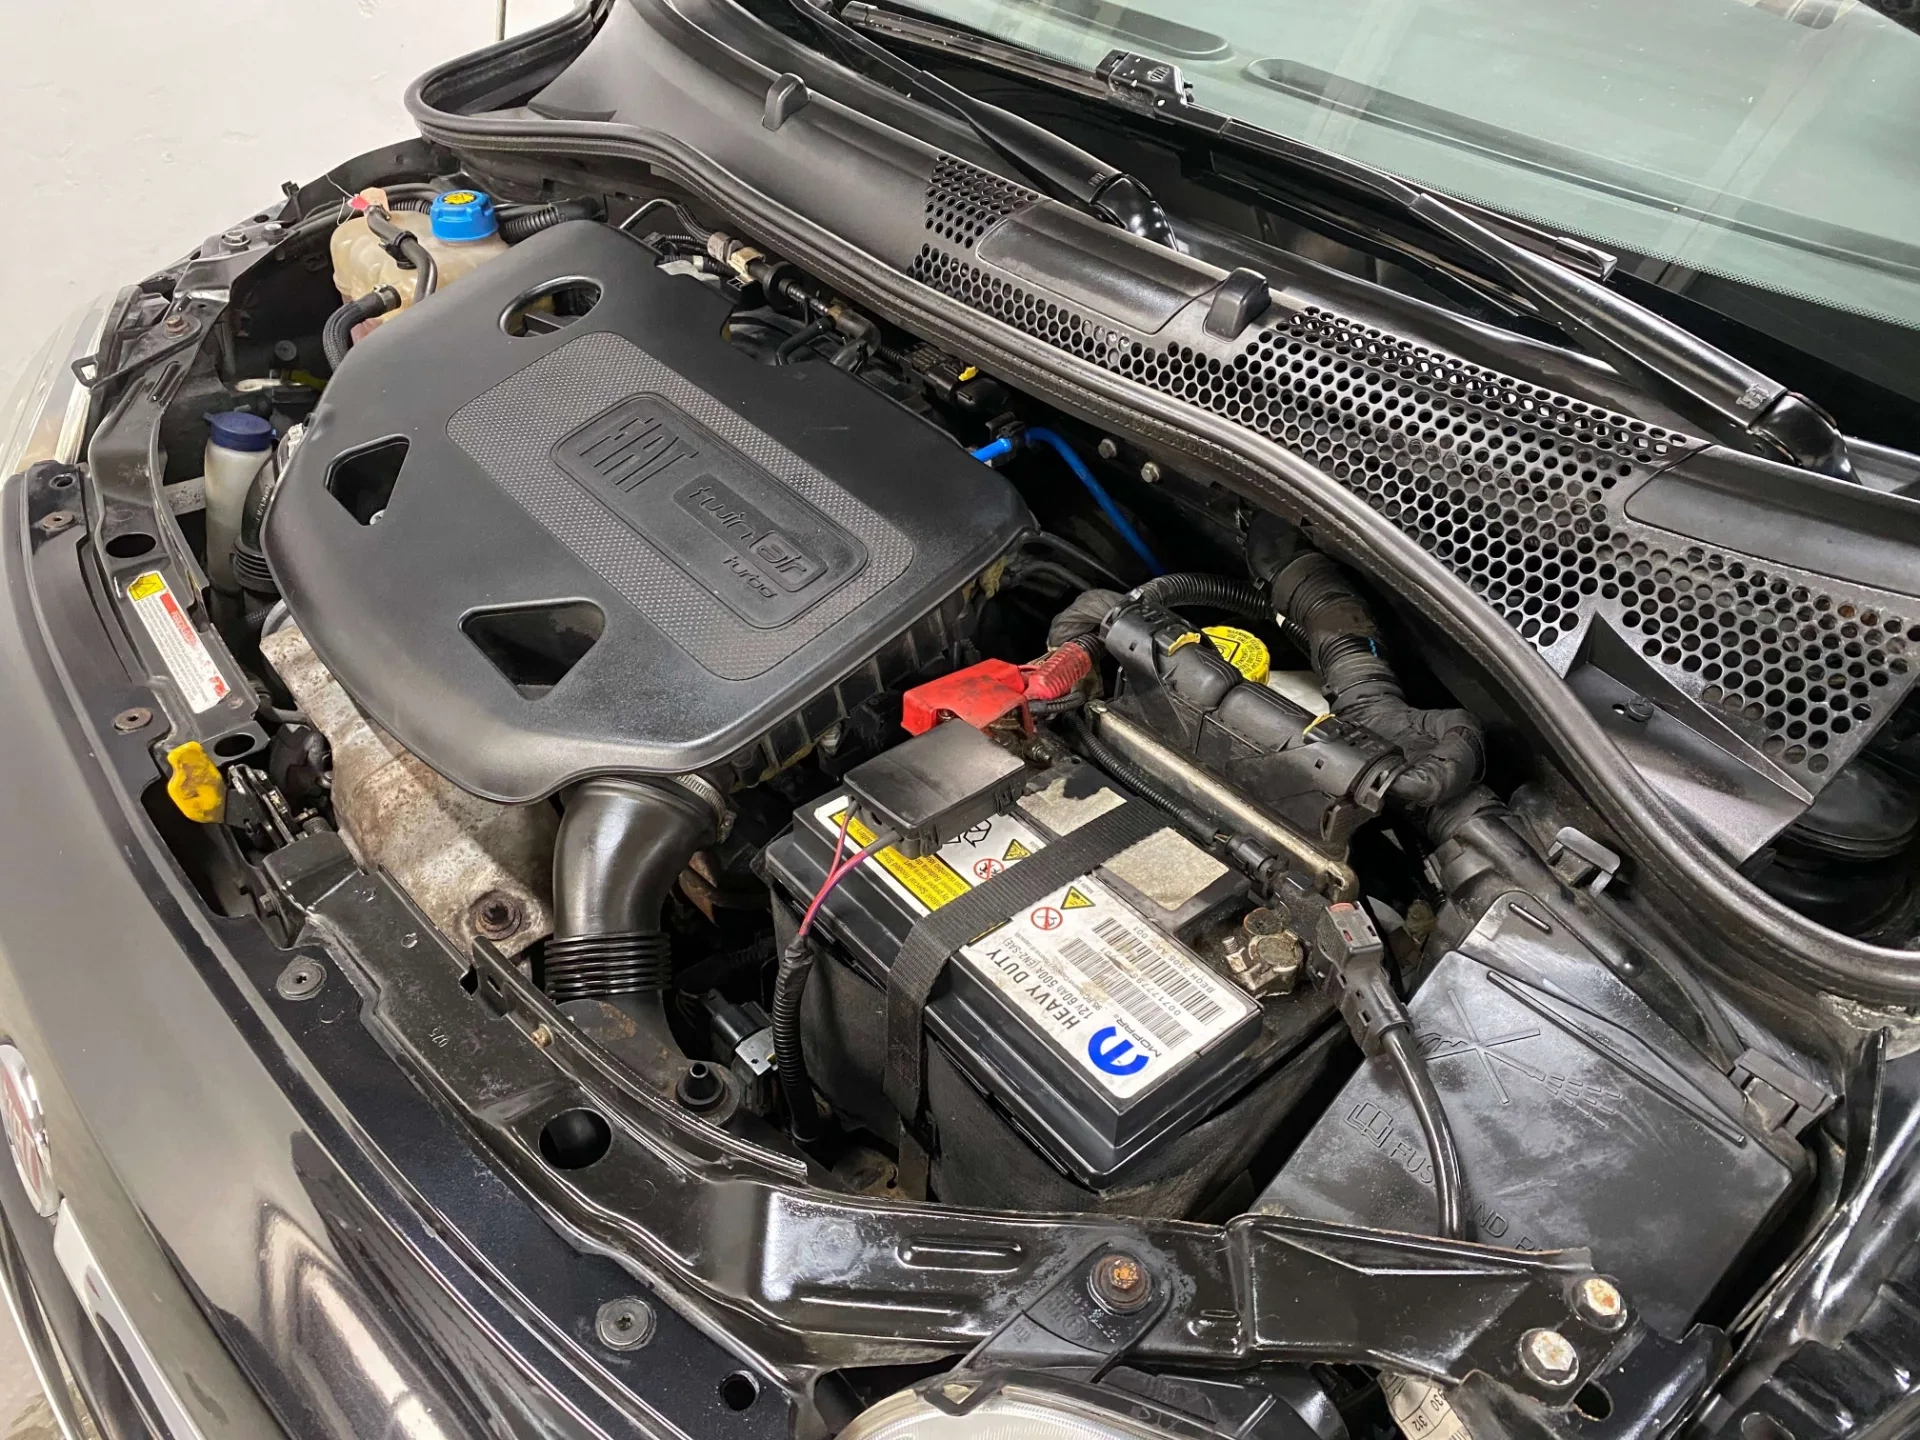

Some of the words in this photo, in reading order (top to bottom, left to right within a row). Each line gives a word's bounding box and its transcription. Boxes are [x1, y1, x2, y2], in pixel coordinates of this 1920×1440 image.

[579, 417, 699, 492] FIAT
[985, 947, 1031, 983] DUTY
[1001, 936, 1041, 969] (EN2-SAE)
[1032, 965, 1058, 988] 500A
[1025, 982, 1081, 1029] HEAVY
[1054, 984, 1079, 1006] 60Ah
[1114, 1016, 1162, 1056] MOPAR
[1389, 1140, 1437, 1192] FUS
[1412, 1416, 1427, 1431] 312
